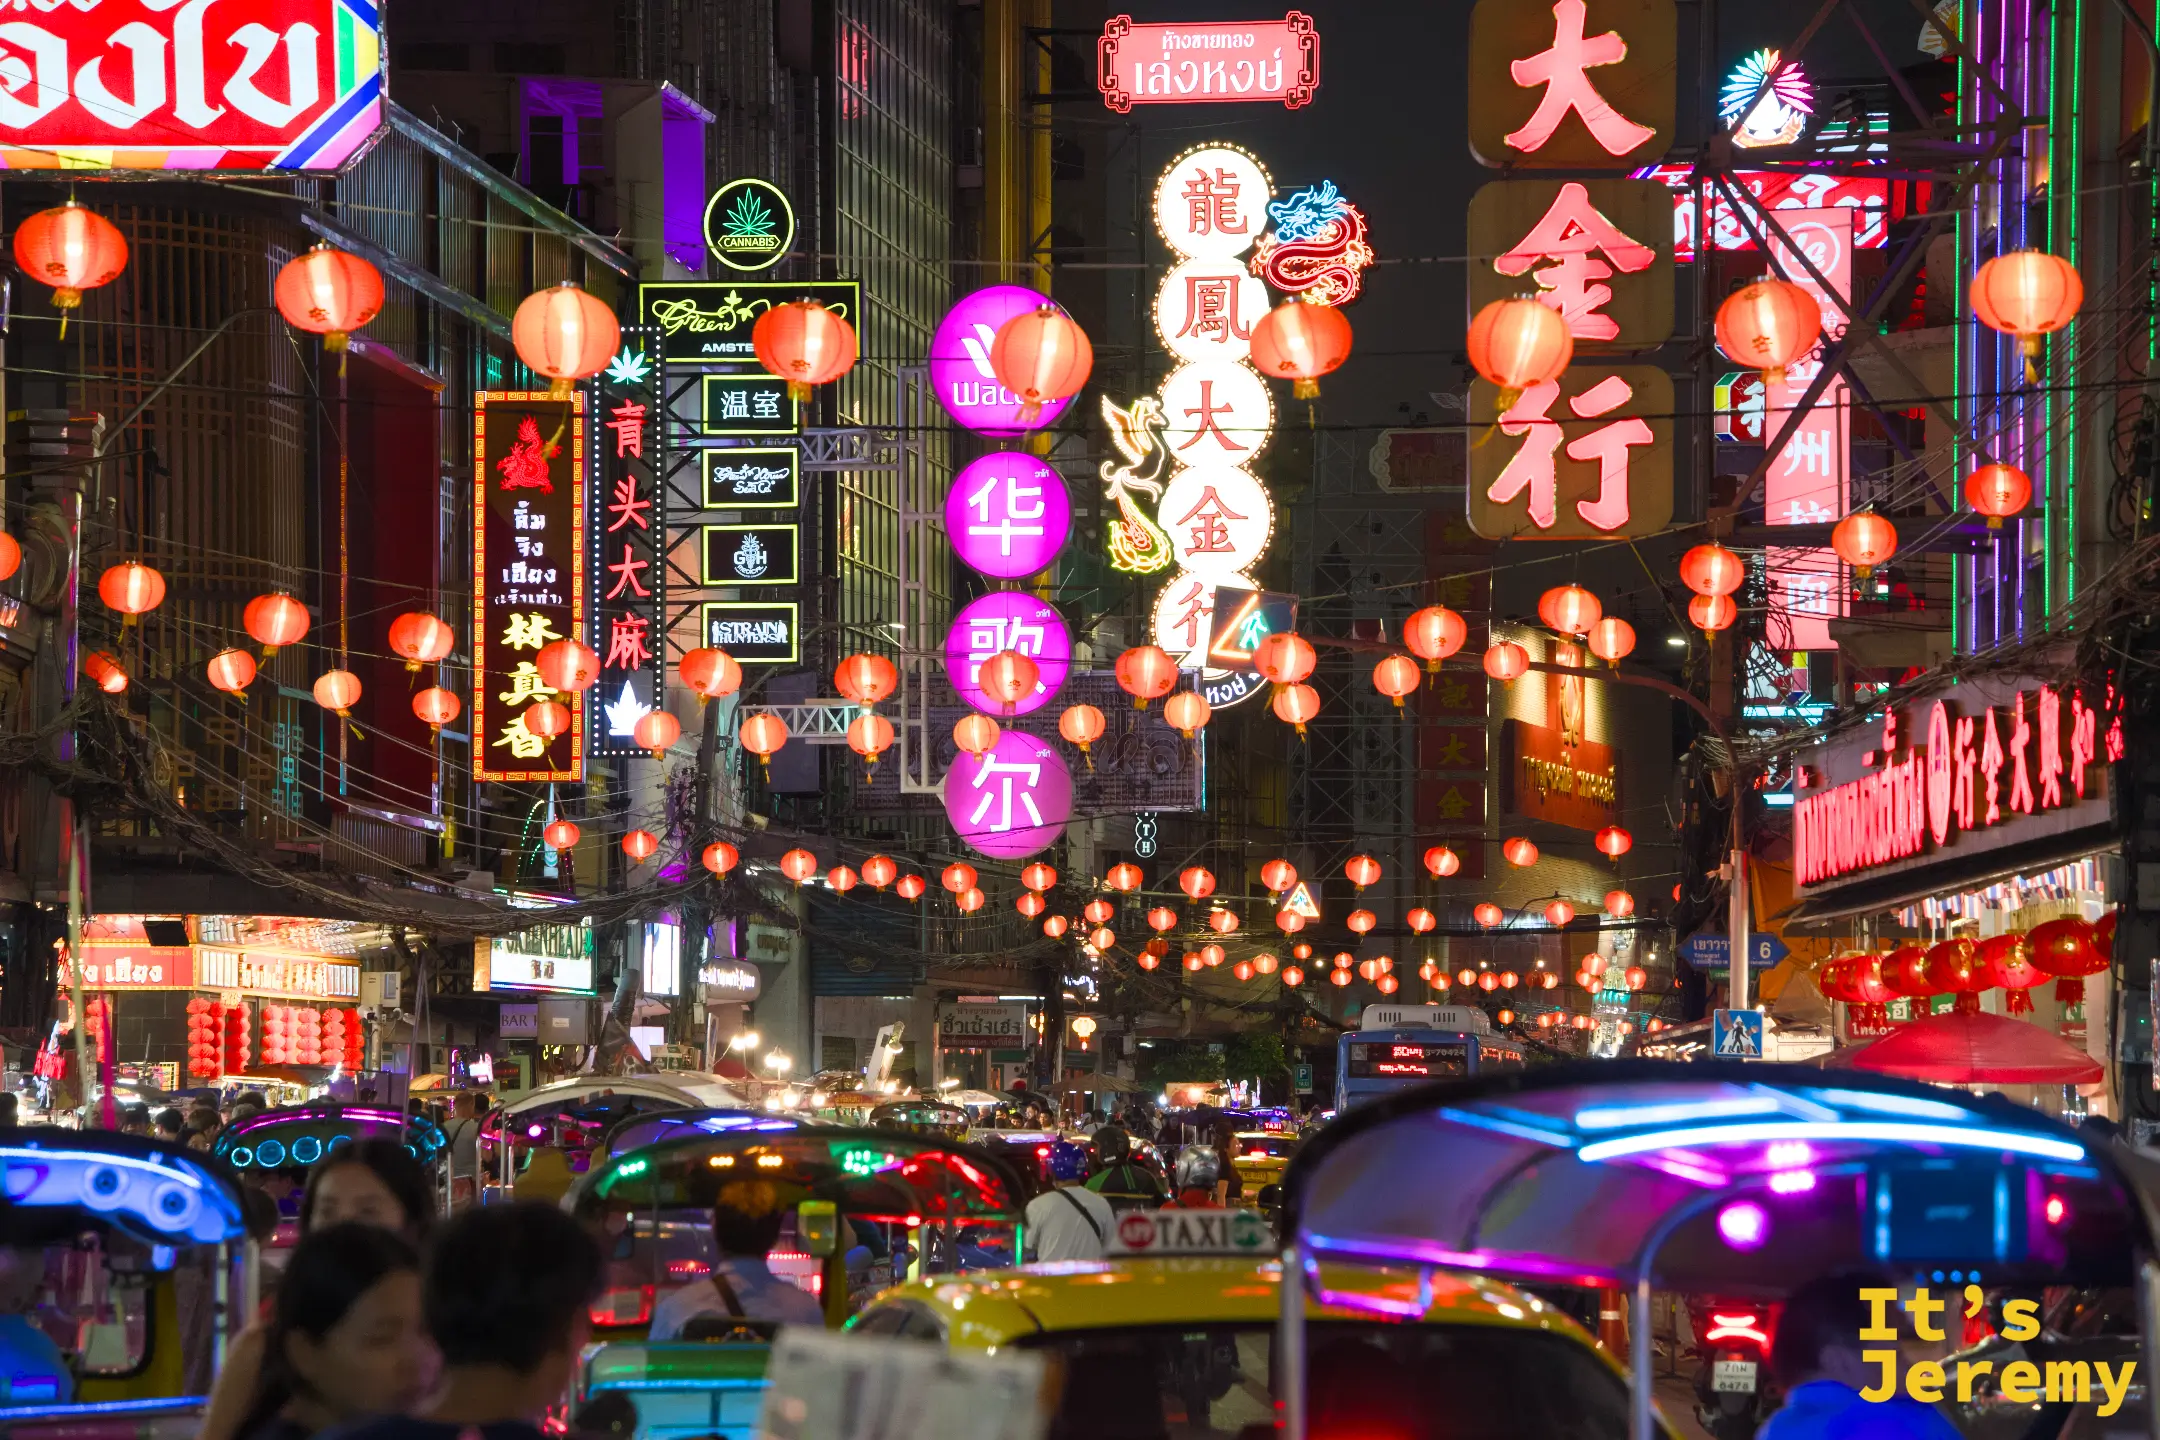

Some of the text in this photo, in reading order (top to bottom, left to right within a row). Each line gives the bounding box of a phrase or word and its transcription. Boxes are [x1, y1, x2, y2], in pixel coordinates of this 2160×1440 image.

[1161, 30, 1255, 50] ห้างขายทอง
[1134, 47, 1284, 96] เล่งหงษ์
[722, 236, 776, 248] CANNABIS
[1488, 0, 1656, 530] 大金行
[701, 342, 754, 354] AMSTE
[720, 389, 781, 420] 温室
[604, 398, 653, 671] 青头大麻
[719, 621, 779, 635] STRAIN
[492, 611, 564, 759] 林真香
[1759, 941, 1772, 959] 6
[501, 1014, 528, 1028] BAR
[1299, 1068, 1307, 1079] P
[1264, 1122, 1282, 1130] TAXI
[1155, 1215, 1230, 1247] TAXI
